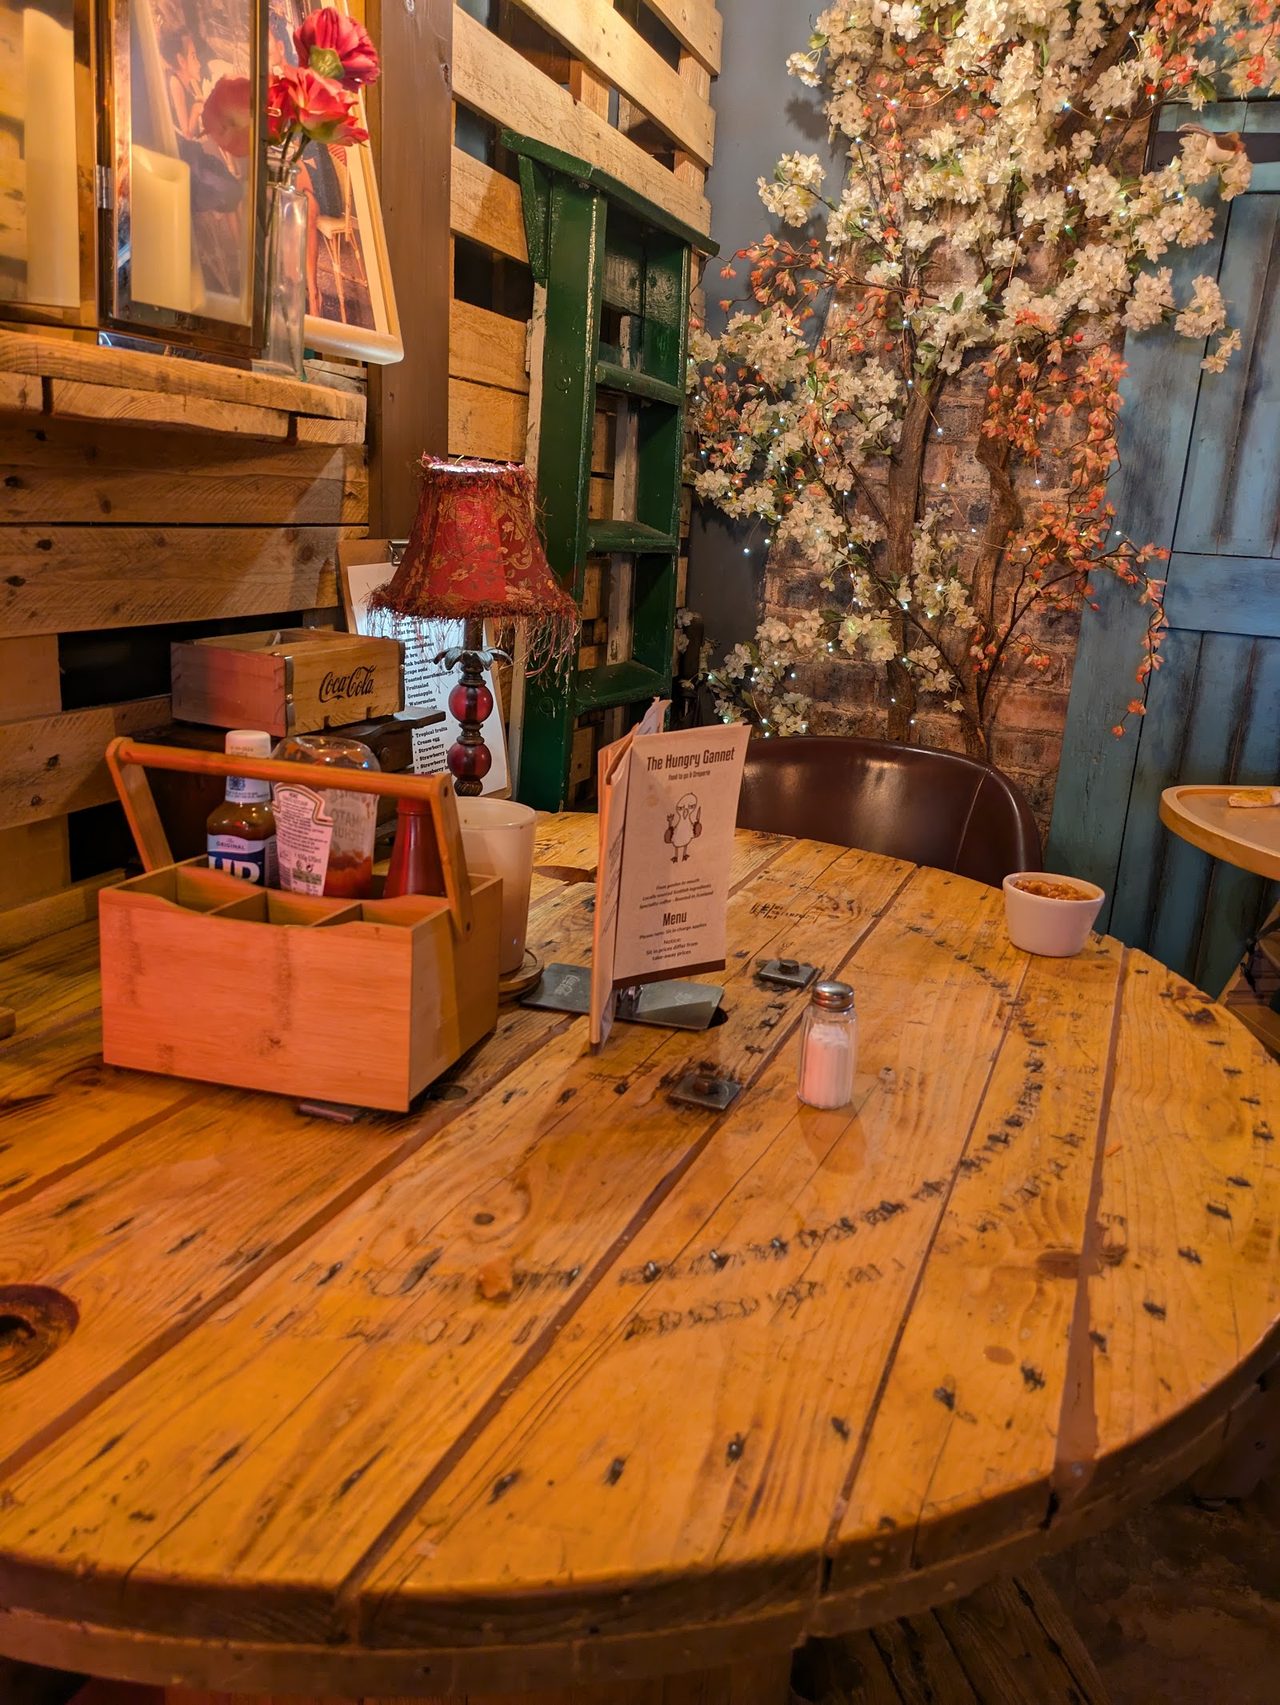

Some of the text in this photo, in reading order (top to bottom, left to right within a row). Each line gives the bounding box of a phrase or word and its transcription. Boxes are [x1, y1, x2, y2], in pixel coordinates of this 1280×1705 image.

[647, 747, 735, 771] The Hungry Gannet
[662, 912, 687, 927] Menu
